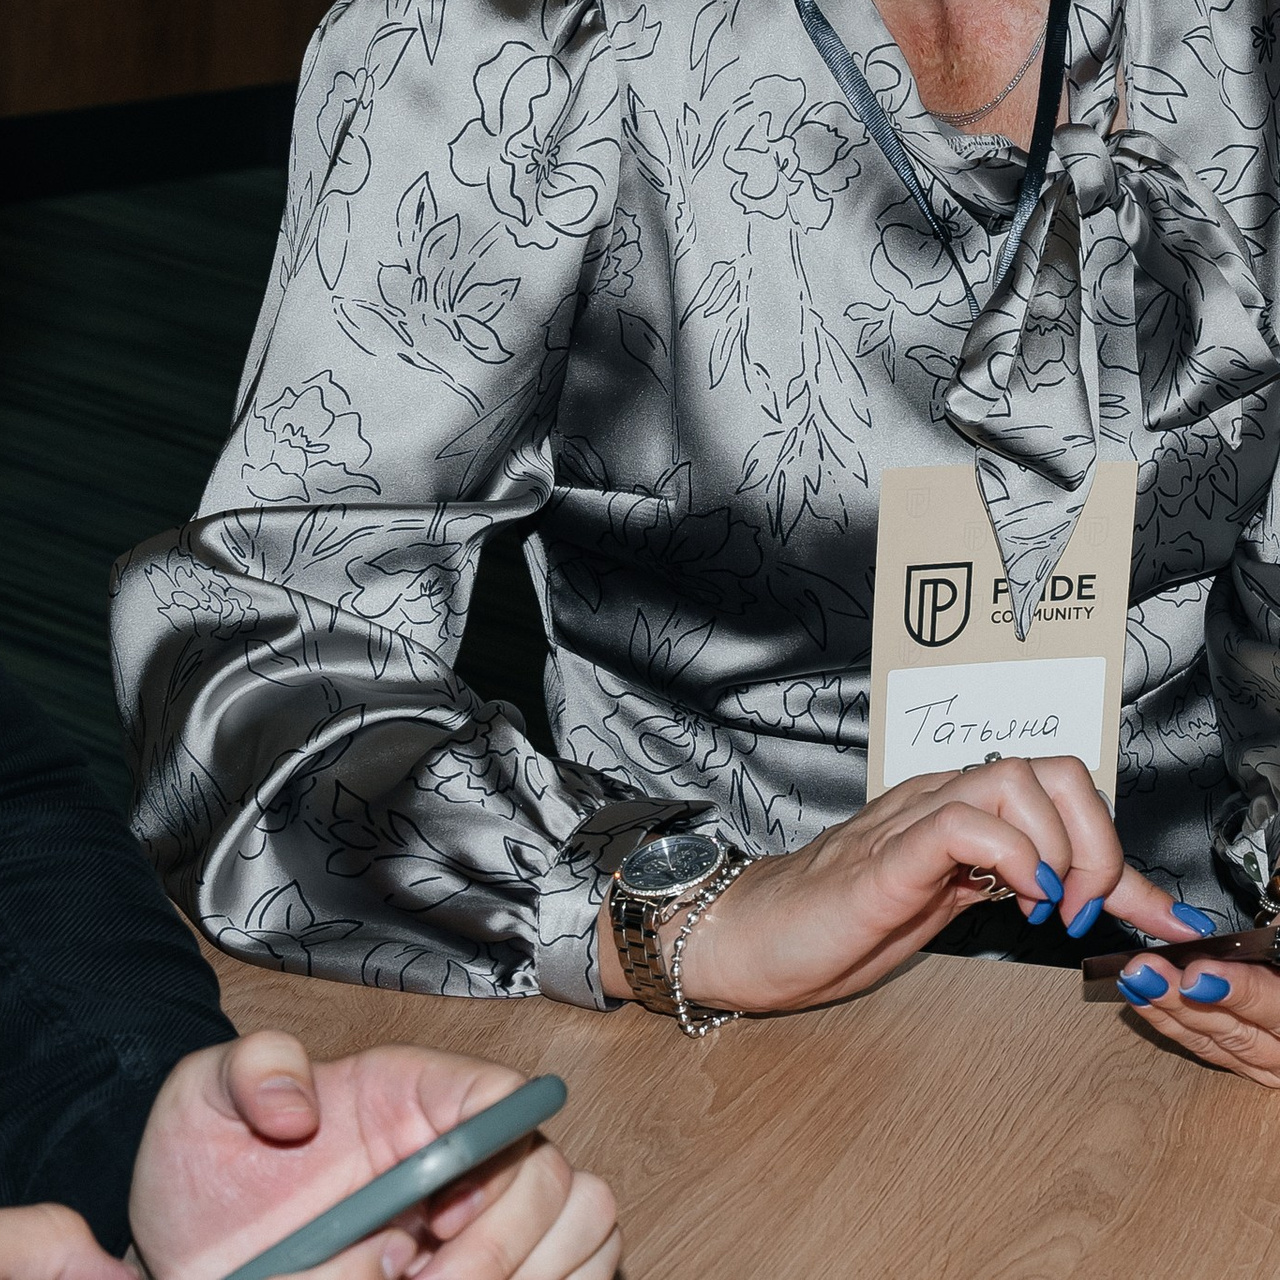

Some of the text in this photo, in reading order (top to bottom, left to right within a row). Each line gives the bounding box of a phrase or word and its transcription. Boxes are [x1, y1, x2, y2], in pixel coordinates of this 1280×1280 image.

[993, 574, 1096, 604] PDE
[990, 606, 1095, 624] COMUNITY
[904, 693, 1061, 747] Татьяна
